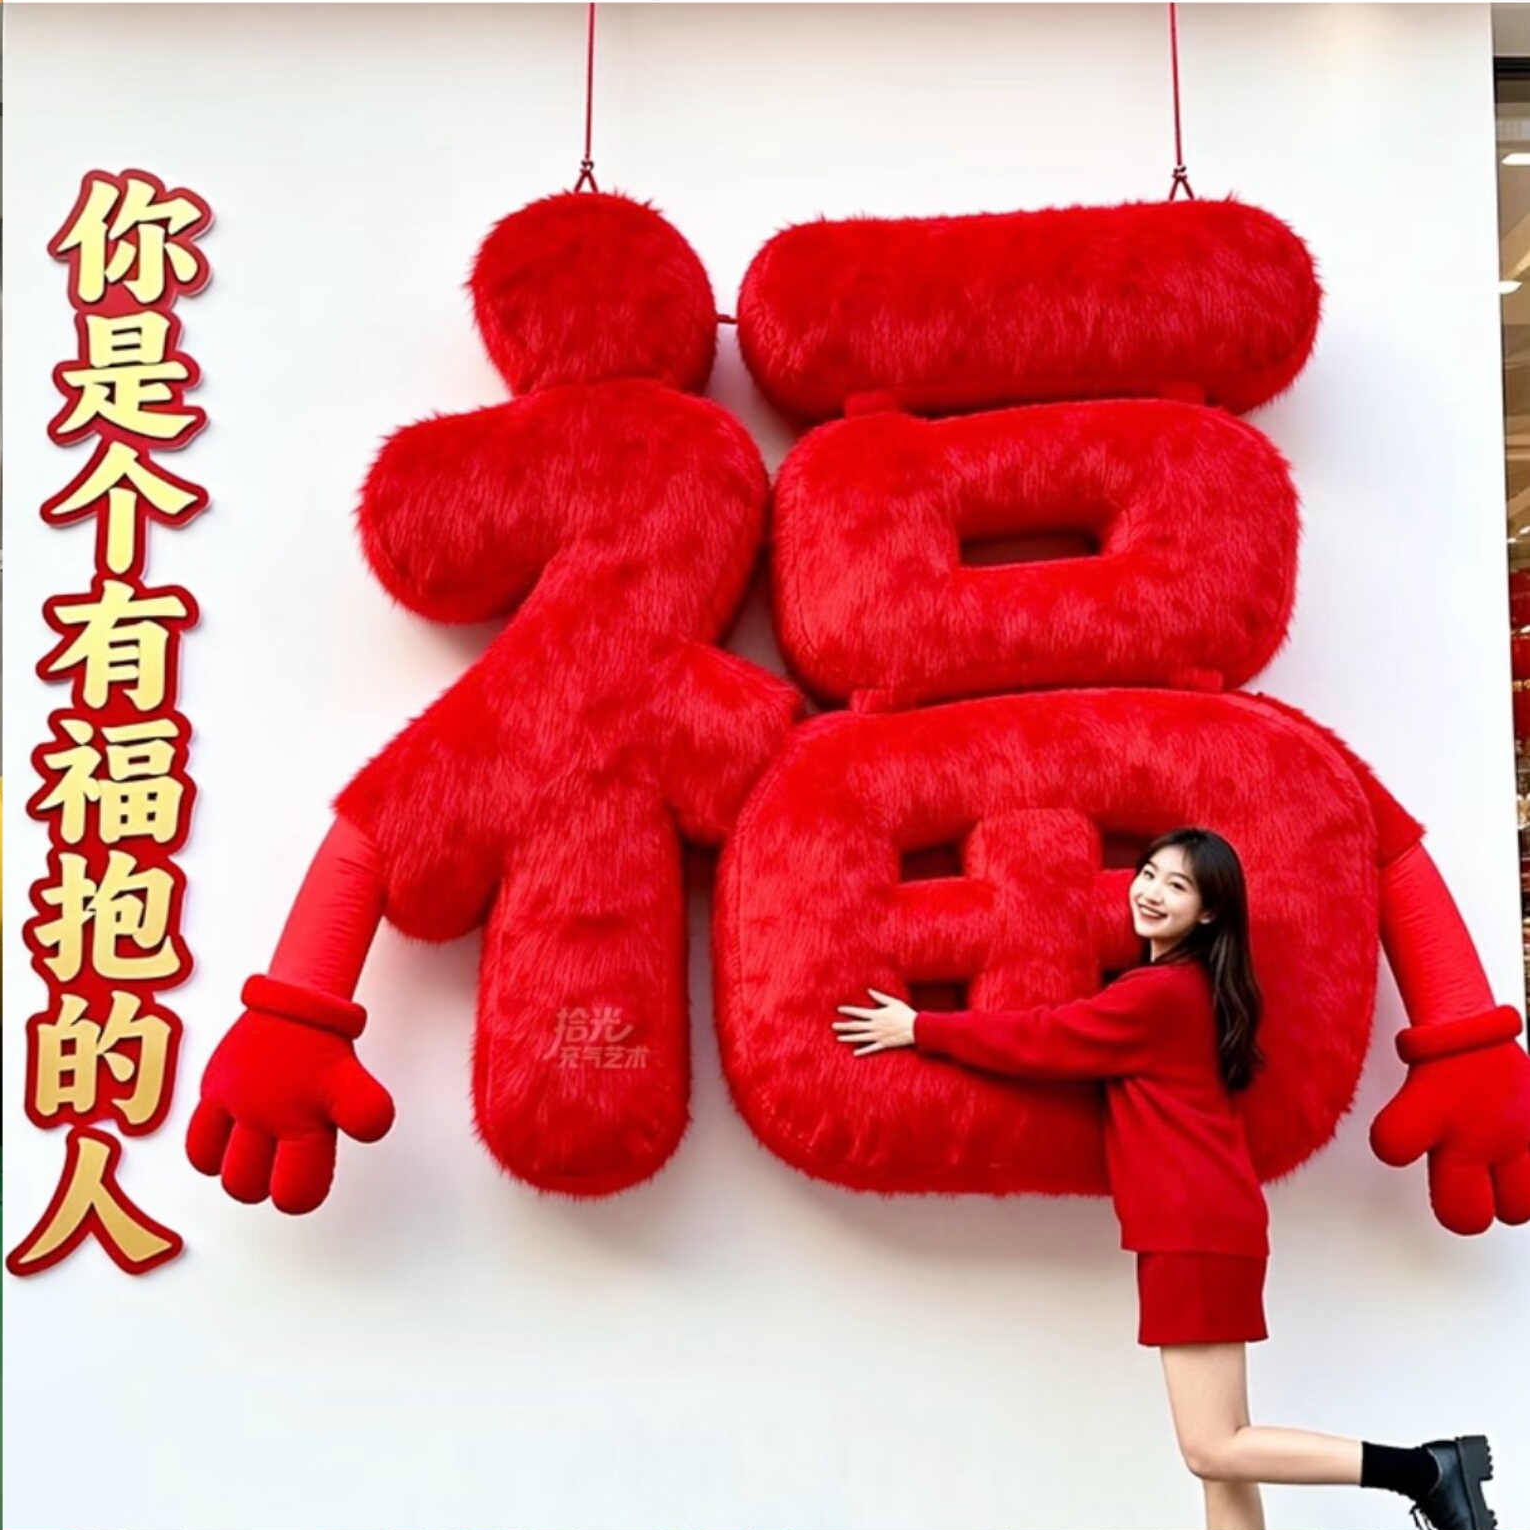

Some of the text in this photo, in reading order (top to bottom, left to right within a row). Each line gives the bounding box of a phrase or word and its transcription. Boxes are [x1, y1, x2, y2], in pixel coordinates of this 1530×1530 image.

[11, 174, 204, 1269] 你是个有福抱的人
